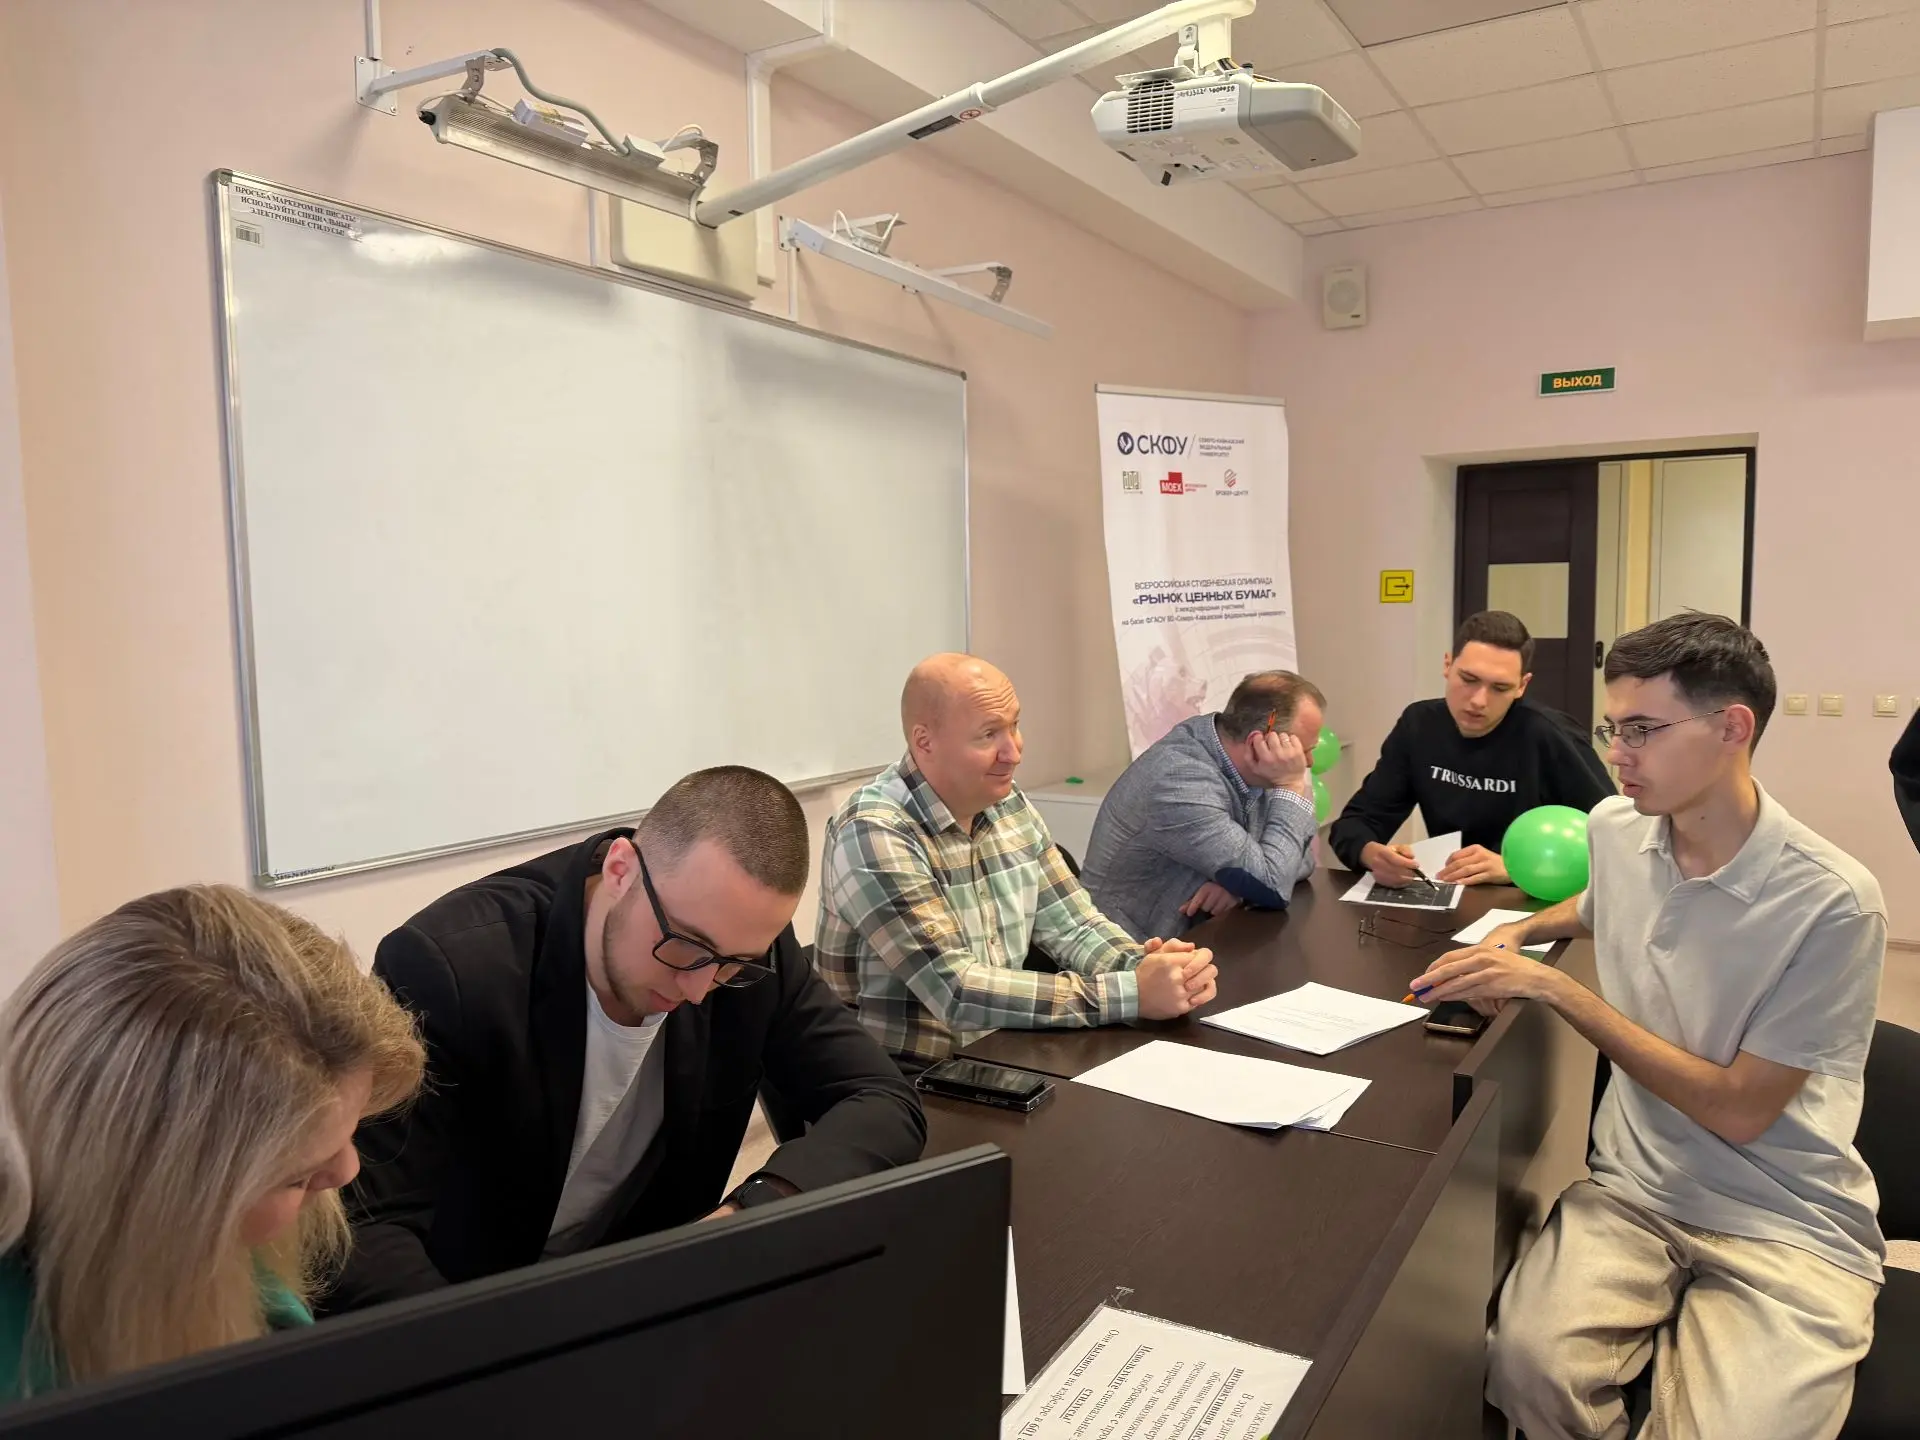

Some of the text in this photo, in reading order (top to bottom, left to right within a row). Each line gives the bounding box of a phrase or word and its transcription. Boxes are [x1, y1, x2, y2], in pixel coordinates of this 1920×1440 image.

[235, 186, 271, 200] ПРОСЬБА
[272, 195, 314, 212] МАРКЕРОМ
[314, 206, 324, 214] НЕ
[241, 196, 352, 230] ИСПОЛЬЗУЙТЕ СПЕЦИАЛЬНЫЕ
[250, 206, 306, 226] ЭЛЕКТРОННЫЕ
[1553, 375, 1602, 388] ВЫХОД
[1137, 434, 1188, 456] СКФУ
[1161, 482, 1183, 492] MOEX
[1134, 577, 1272, 590] ВСЕРОССИЙСКАЯ СТУДЕНЧЕСКАЯ ОЛИМПИАДА
[1132, 588, 1276, 604] «РЫНОК ЦЕННЫХ БУМАГ»
[1430, 766, 1516, 793] TRUSSARDI
[1100, 1328, 1119, 1344] Они
[1073, 1343, 1105, 1378] выдаются
[1063, 1378, 1074, 1387] на
[1074, 1345, 1153, 1437] Используйте специальные
[1196, 1370, 1220, 1403] обычным
[1041, 1386, 1068, 1416] кафедре
[1118, 1372, 1153, 1418] изображение
[1205, 1368, 1243, 1424] интерактивная
[1241, 1392, 1254, 1400] В
[1232, 1401, 1246, 1417] этой
[1022, 1423, 1038, 1437] 601
[1111, 1417, 1118, 1425] с
